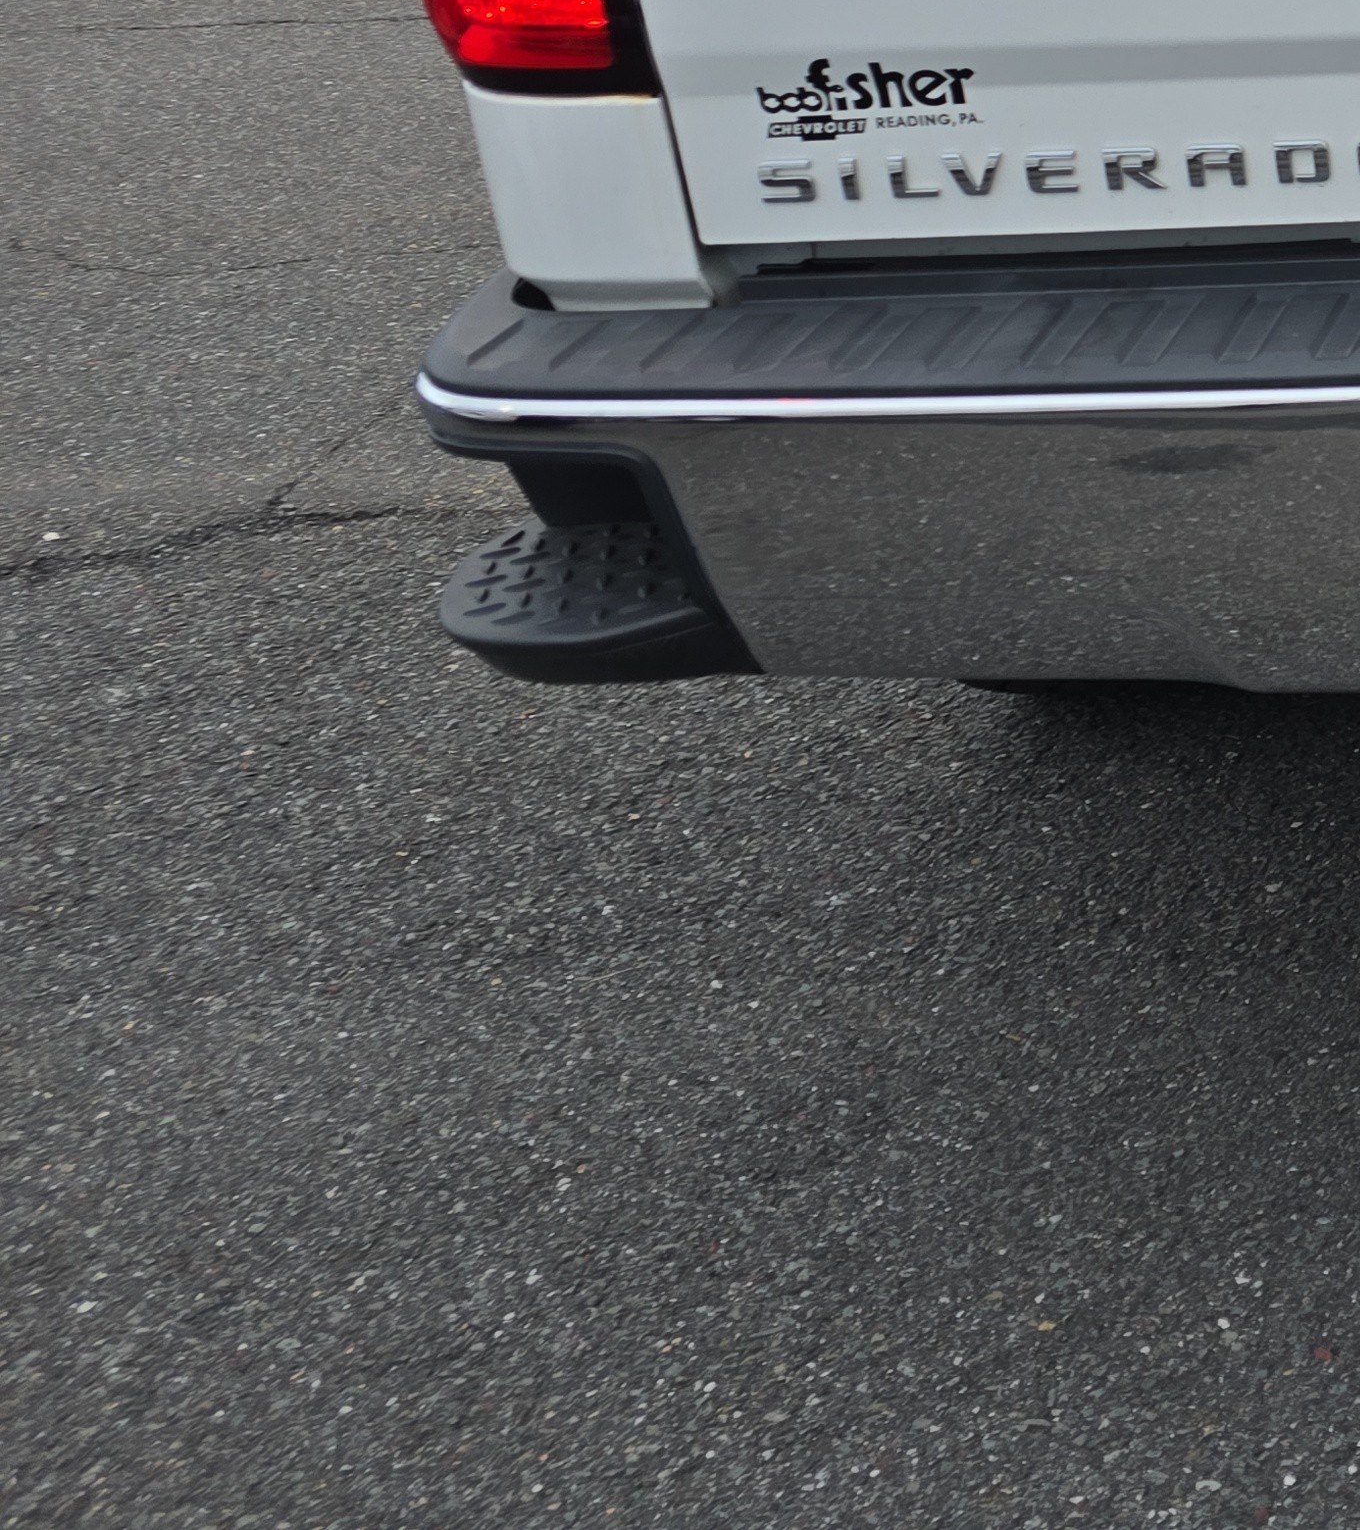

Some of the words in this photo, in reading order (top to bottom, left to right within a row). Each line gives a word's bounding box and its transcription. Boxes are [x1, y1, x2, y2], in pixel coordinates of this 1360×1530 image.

[806, 58, 975, 111] fisher
[769, 120, 865, 137] CHEVROLET
[876, 113, 957, 130] READING,
